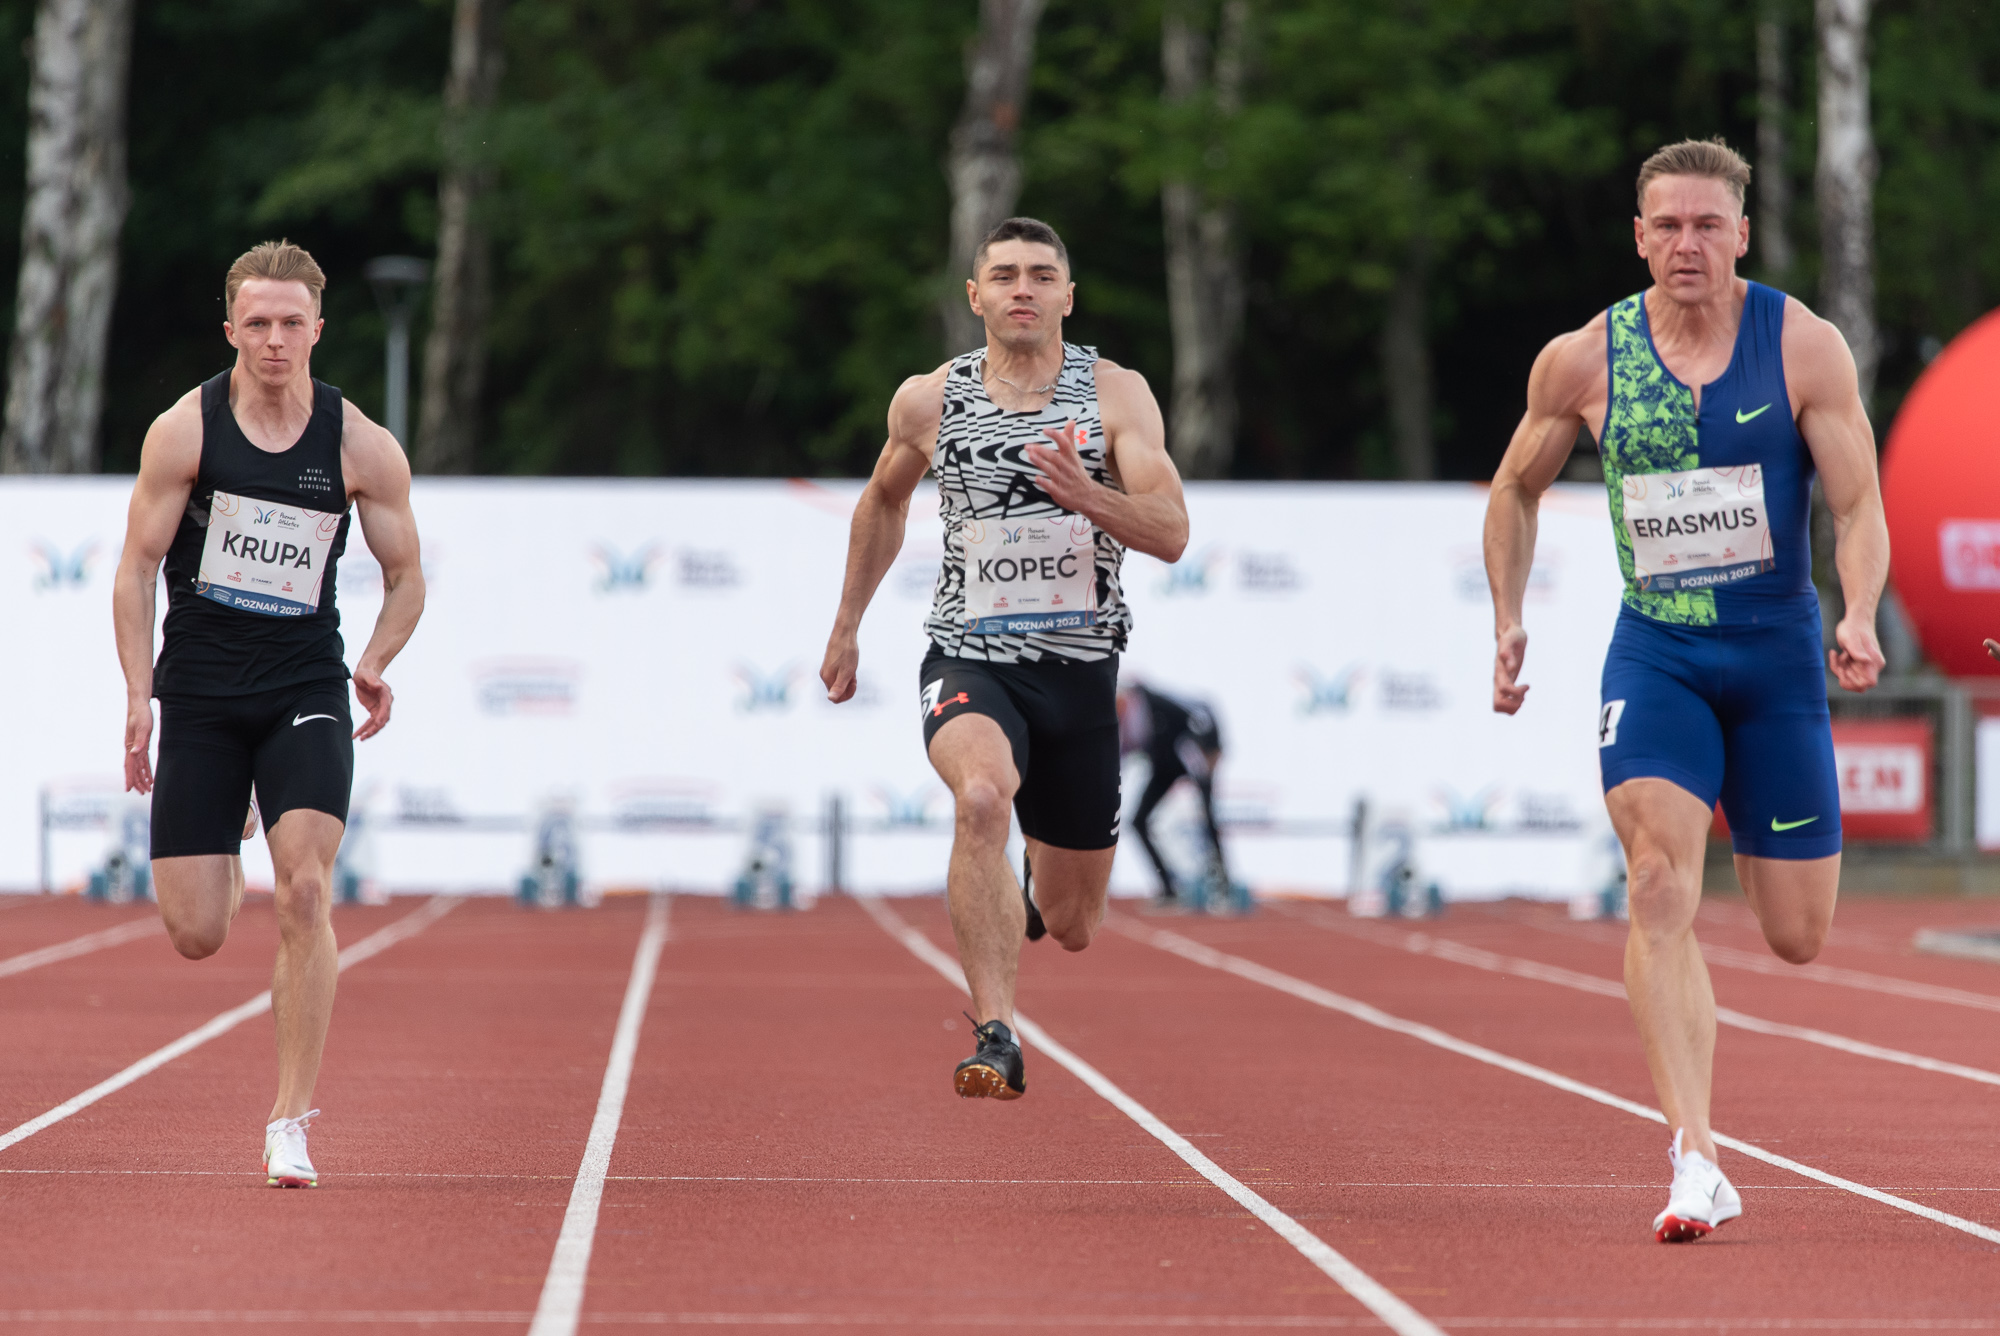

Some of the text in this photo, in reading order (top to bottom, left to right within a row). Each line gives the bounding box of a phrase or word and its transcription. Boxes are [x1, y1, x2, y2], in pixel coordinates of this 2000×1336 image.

[1633, 507, 1758, 538] ERASMUS
[221, 530, 311, 570] KRUPA
[977, 547, 1078, 583] KOPEĆ
[1680, 571, 1728, 588] POZNAŃ
[1729, 565, 1757, 580] 2022
[234, 597, 279, 613] POZNAŃ
[279, 605, 302, 616] 2022
[1007, 618, 1054, 631] POZNAŃ
[1055, 616, 1081, 628] 2022
